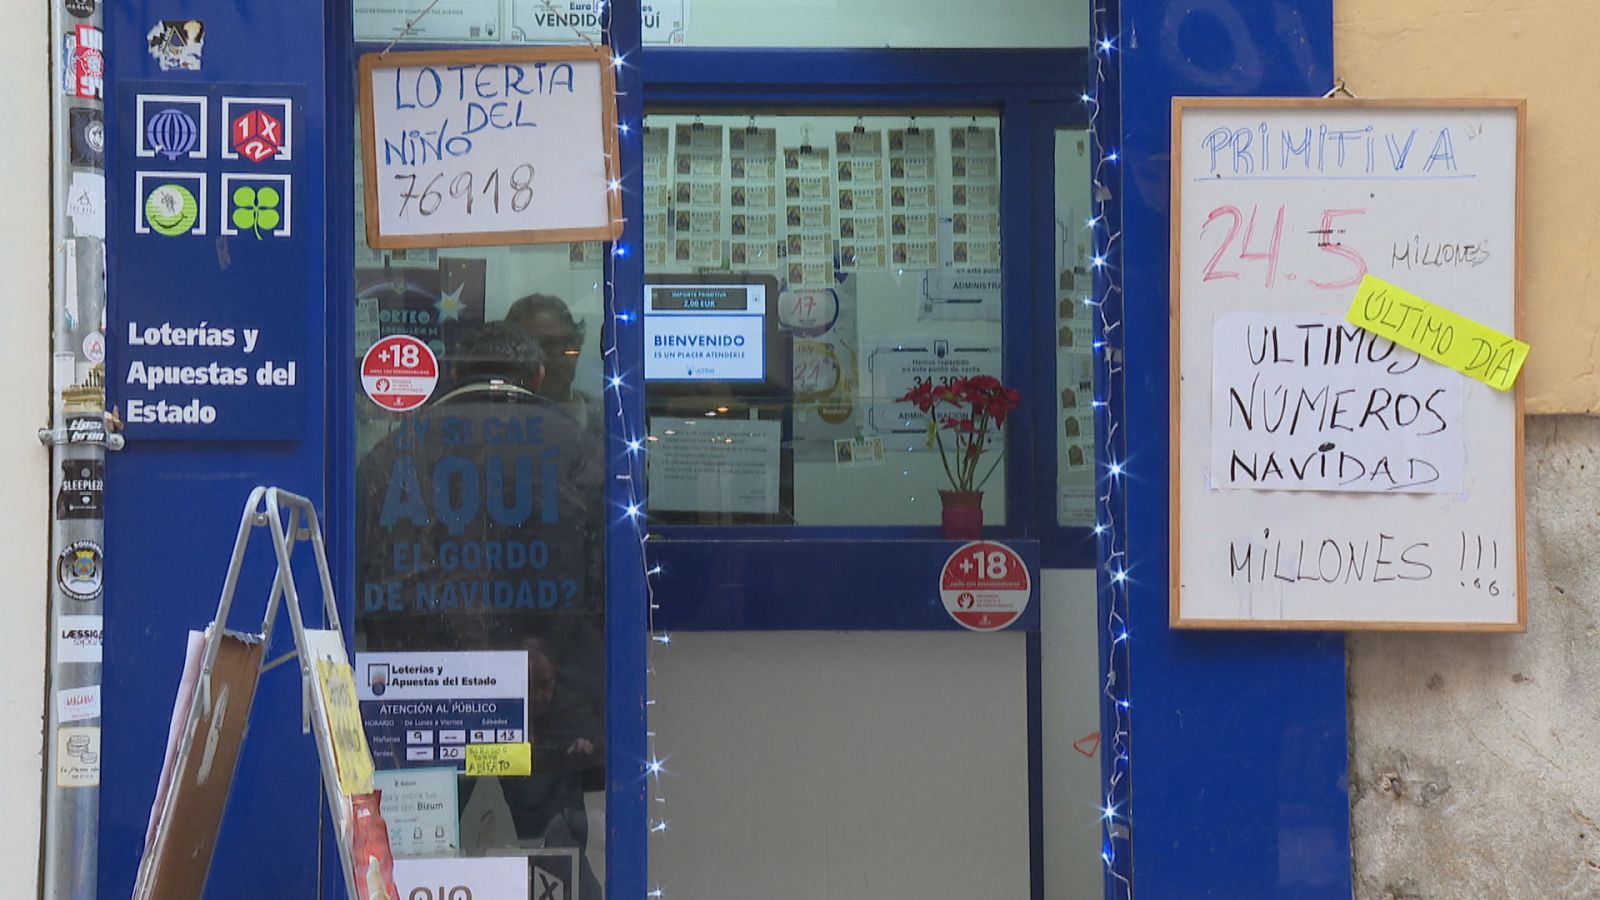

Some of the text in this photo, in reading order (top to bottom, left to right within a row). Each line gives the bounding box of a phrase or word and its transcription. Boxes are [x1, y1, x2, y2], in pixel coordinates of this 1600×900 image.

[462, 100, 537, 135] DEL
[384, 118, 472, 167] NIÑO
[1201, 121, 1458, 174] PRIMITIVA
[394, 163, 536, 217] 76918
[1391, 235, 1491, 271] MILLONES
[128, 321, 259, 353] Loterías y
[654, 335, 745, 346] BIENVENIDO
[1363, 288, 1516, 387] ÚLTIMO DÍA
[378, 344, 420, 369] +18
[664, 351, 676, 359] UN
[677, 351, 704, 359] PLACER
[706, 351, 745, 359] ATENDERLE
[126, 361, 296, 391] Apuestas del
[126, 398, 217, 424] Estado
[1229, 373, 1448, 436] NÚMEROS
[442, 417, 471, 445] SI
[483, 416, 544, 445] CAE
[1230, 442, 1440, 491] NAVIDAD
[379, 446, 560, 536] AQUÍ
[393, 540, 549, 571] EL GORDO
[959, 551, 1008, 579] +18
[1230, 528, 1433, 584] MILLONES
[364, 578, 578, 613] DE NAVIDAD?
[391, 664, 443, 675] Loterías y
[391, 677, 497, 688] Apuestas del Estado
[379, 702, 497, 715] ATENCIÓN AL PÚBLICO
[404, 719, 413, 727] De
[414, 719, 434, 727] Lunes
[440, 718, 464, 726] Viernes
[413, 731, 423, 742] 9
[442, 749, 459, 758] 20
[417, 801, 444, 811] Bizum
